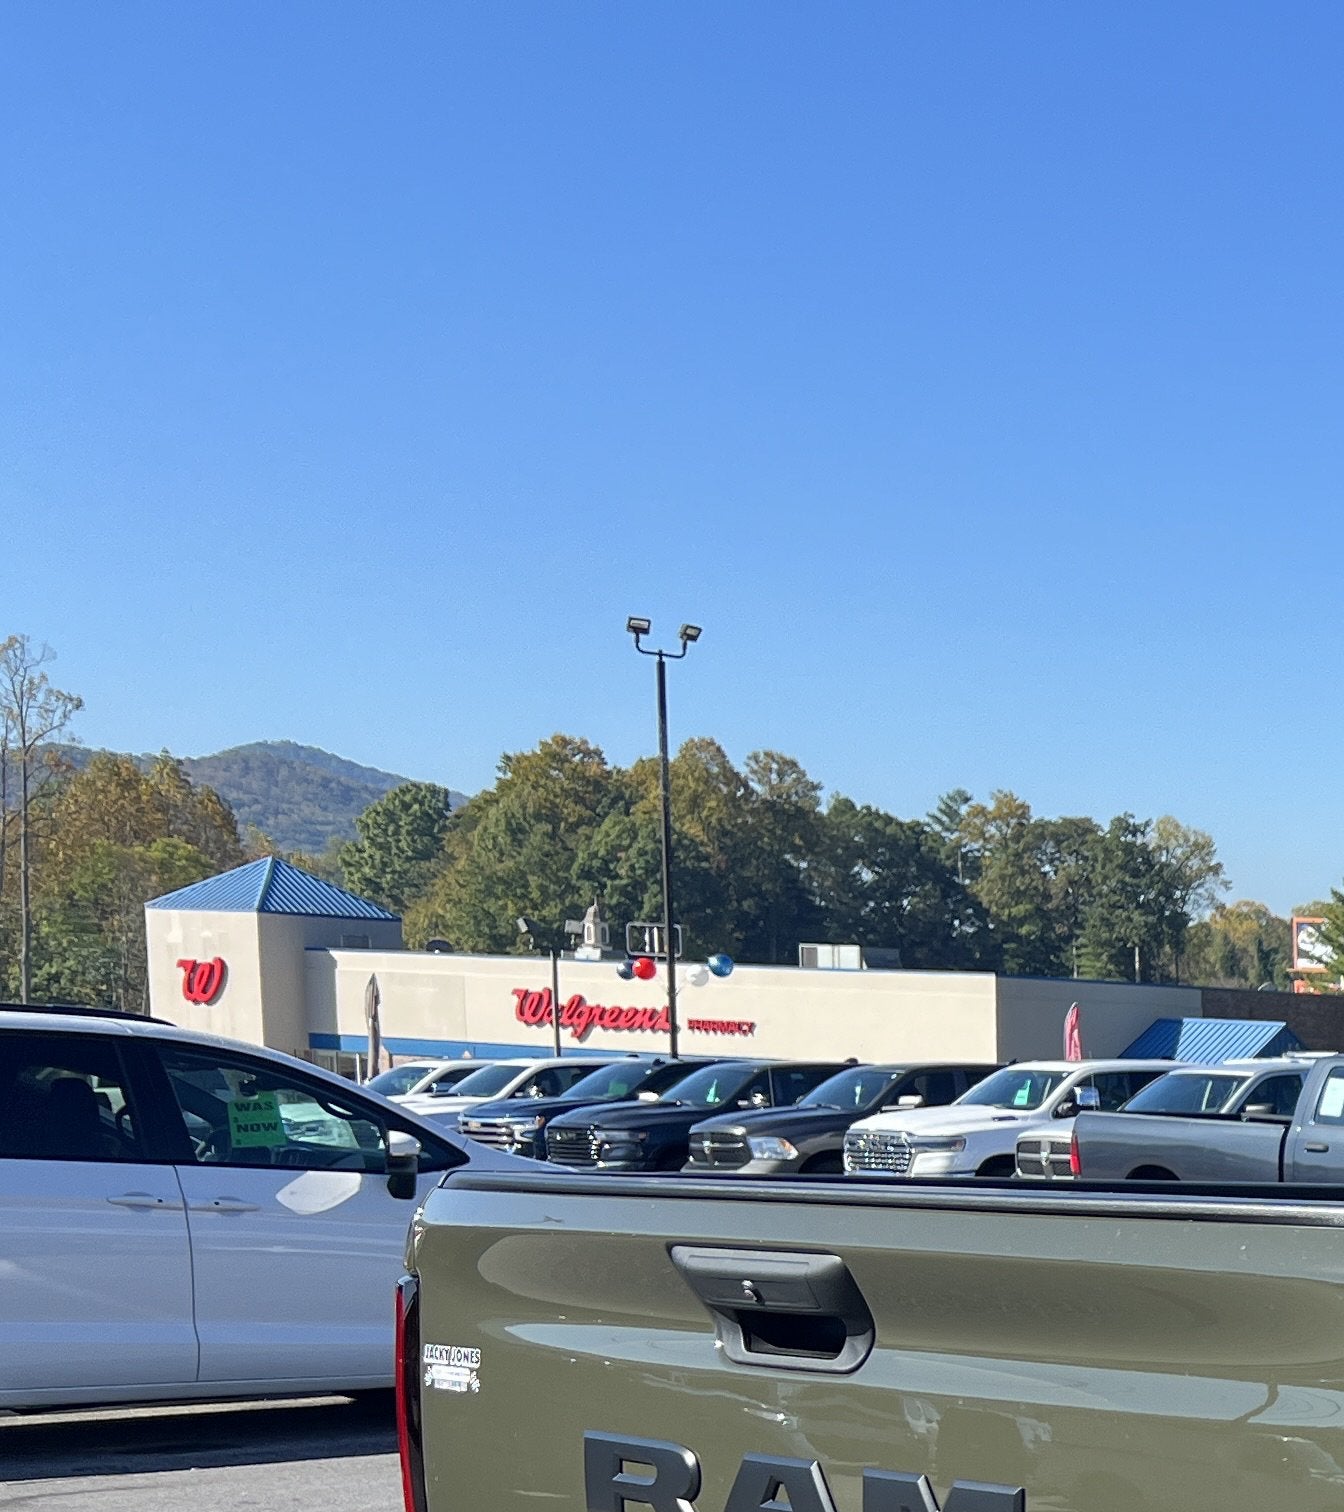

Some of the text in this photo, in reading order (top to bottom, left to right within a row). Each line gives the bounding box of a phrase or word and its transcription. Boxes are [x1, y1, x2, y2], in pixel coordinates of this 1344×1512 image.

[176, 956, 226, 1003] W
[512, 987, 756, 1038] Walgreens PHARMACY
[234, 1101, 275, 1112] WAS
[236, 1122, 278, 1133] NOW
[451, 1347, 480, 1365] JONES
